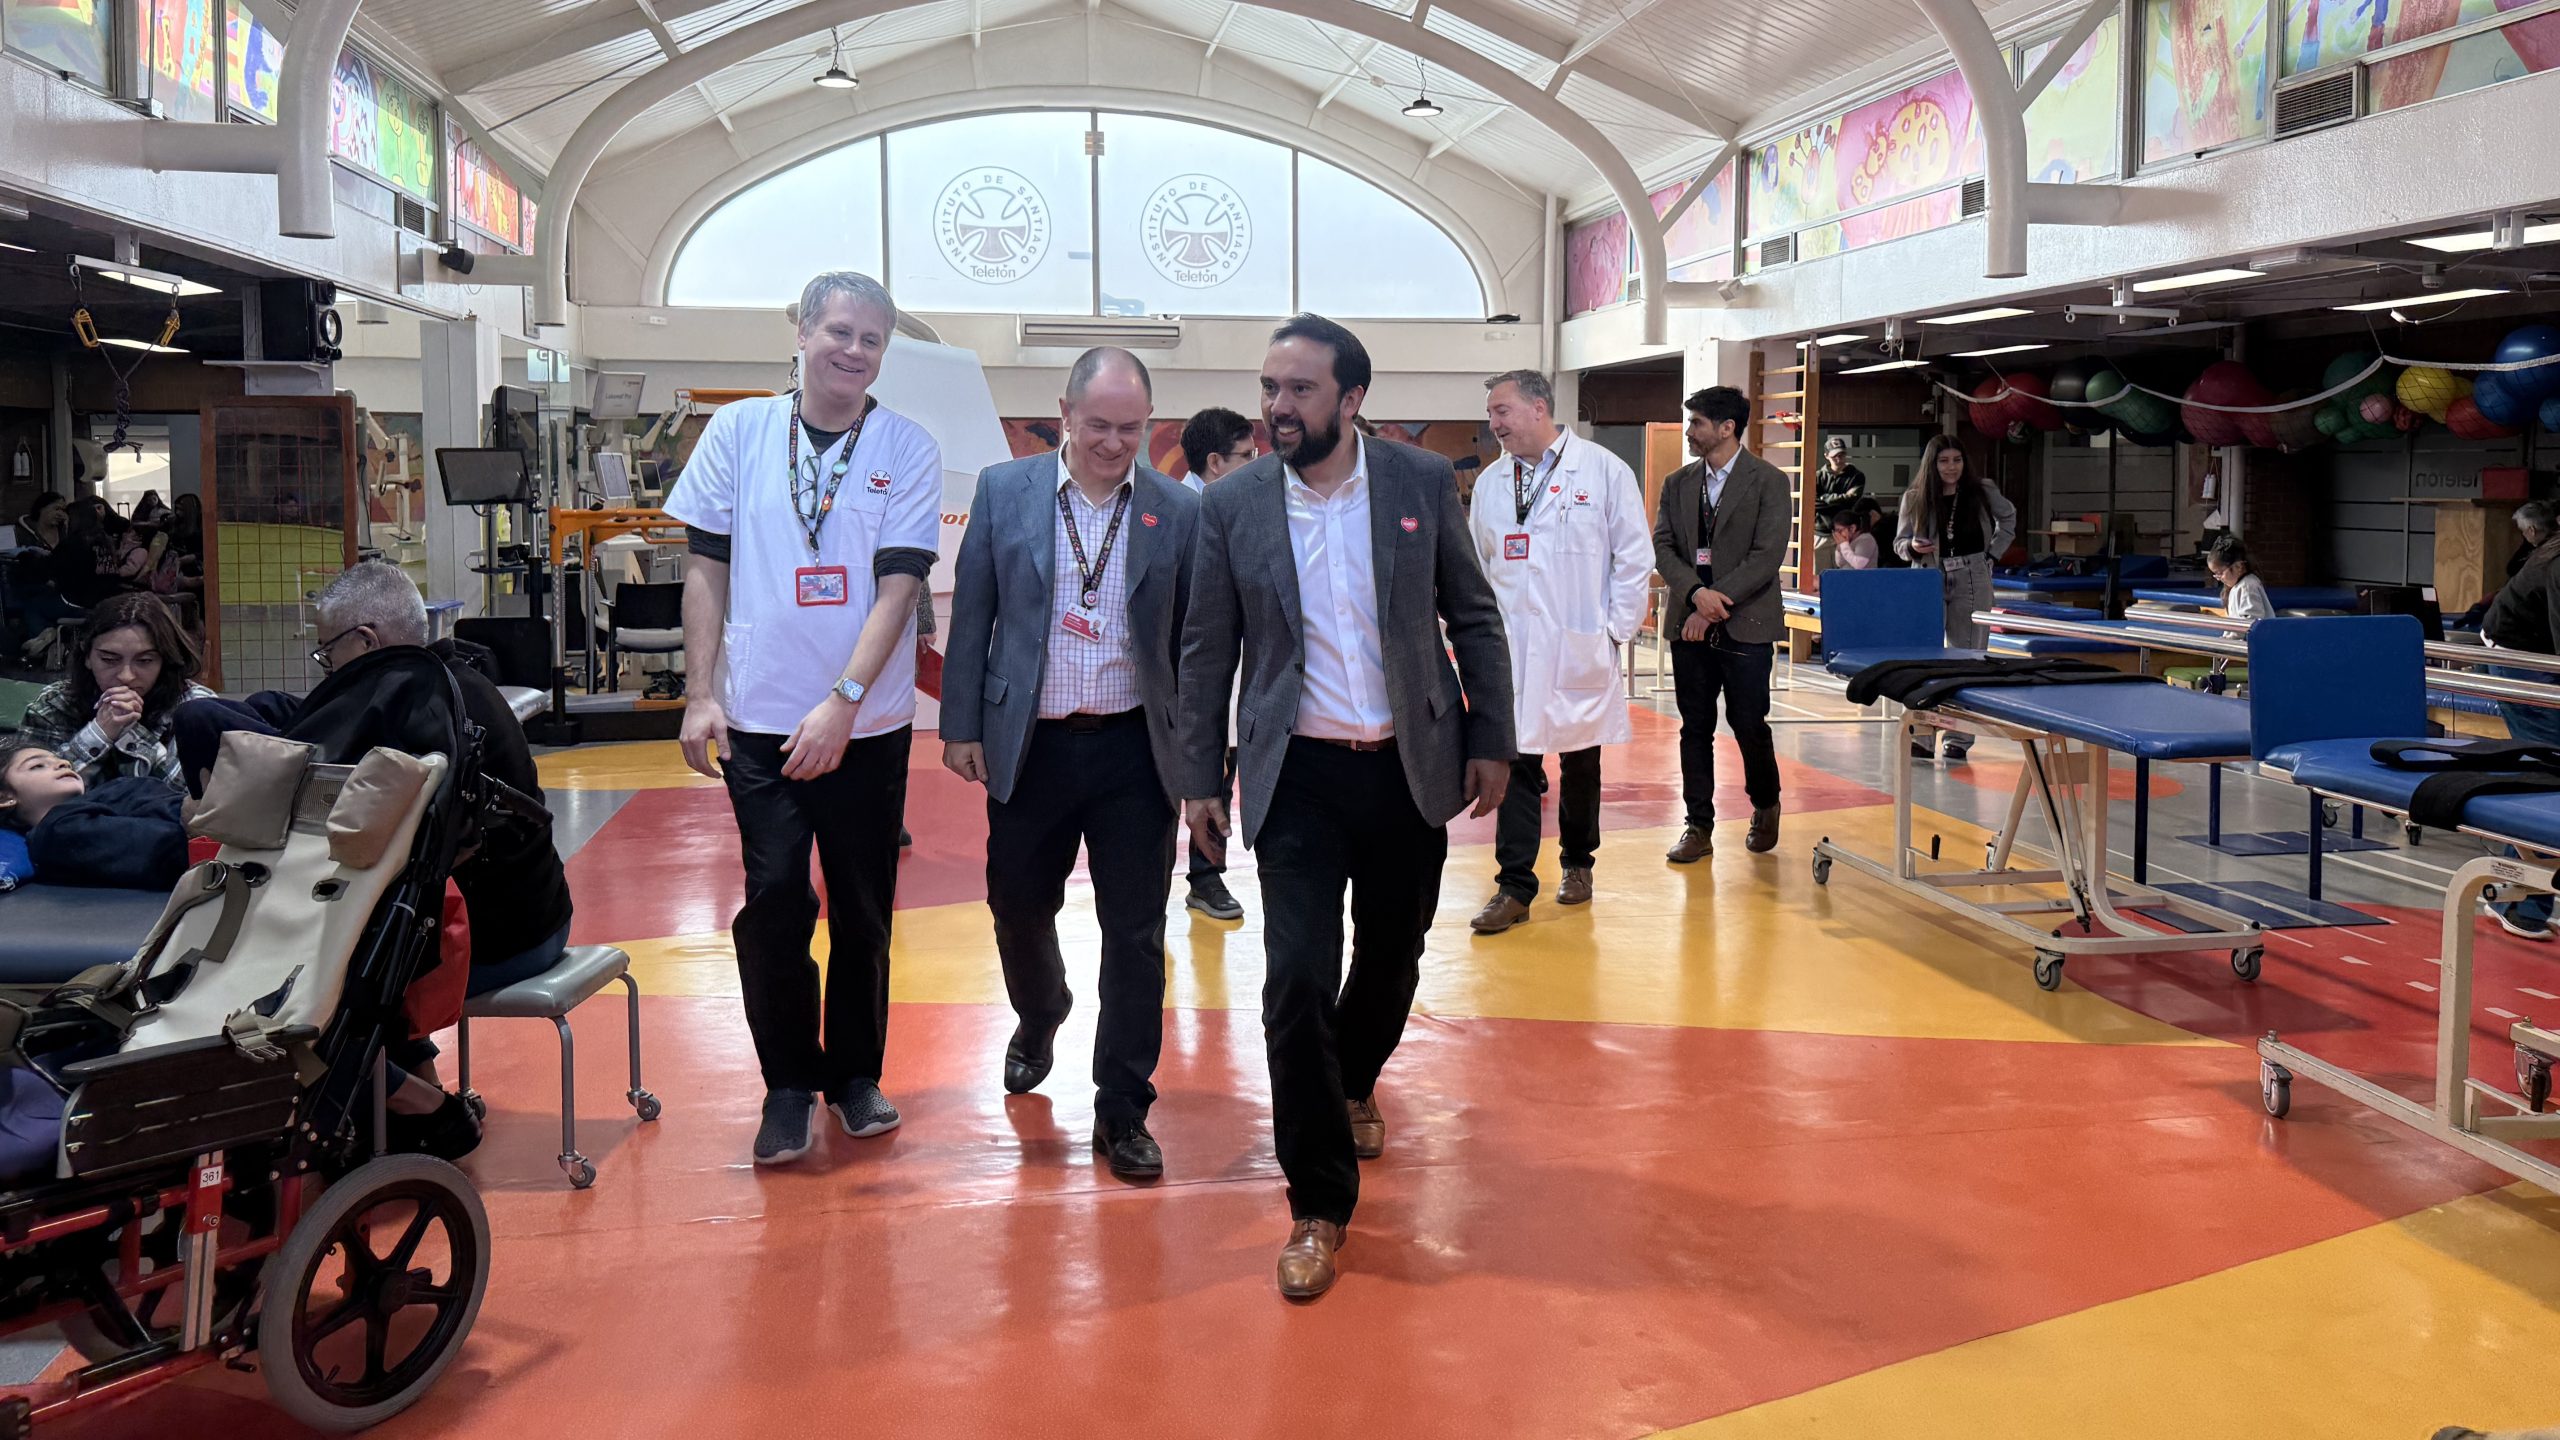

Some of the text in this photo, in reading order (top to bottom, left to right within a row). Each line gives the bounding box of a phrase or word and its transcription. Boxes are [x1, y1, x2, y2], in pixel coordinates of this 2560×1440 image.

[942, 175, 1042, 264] INSTITUTO DE SANTIAGO
[1148, 181, 1244, 269] INSTITUTO DE SANTIAGO
[202, 1170, 220, 1183] 361
